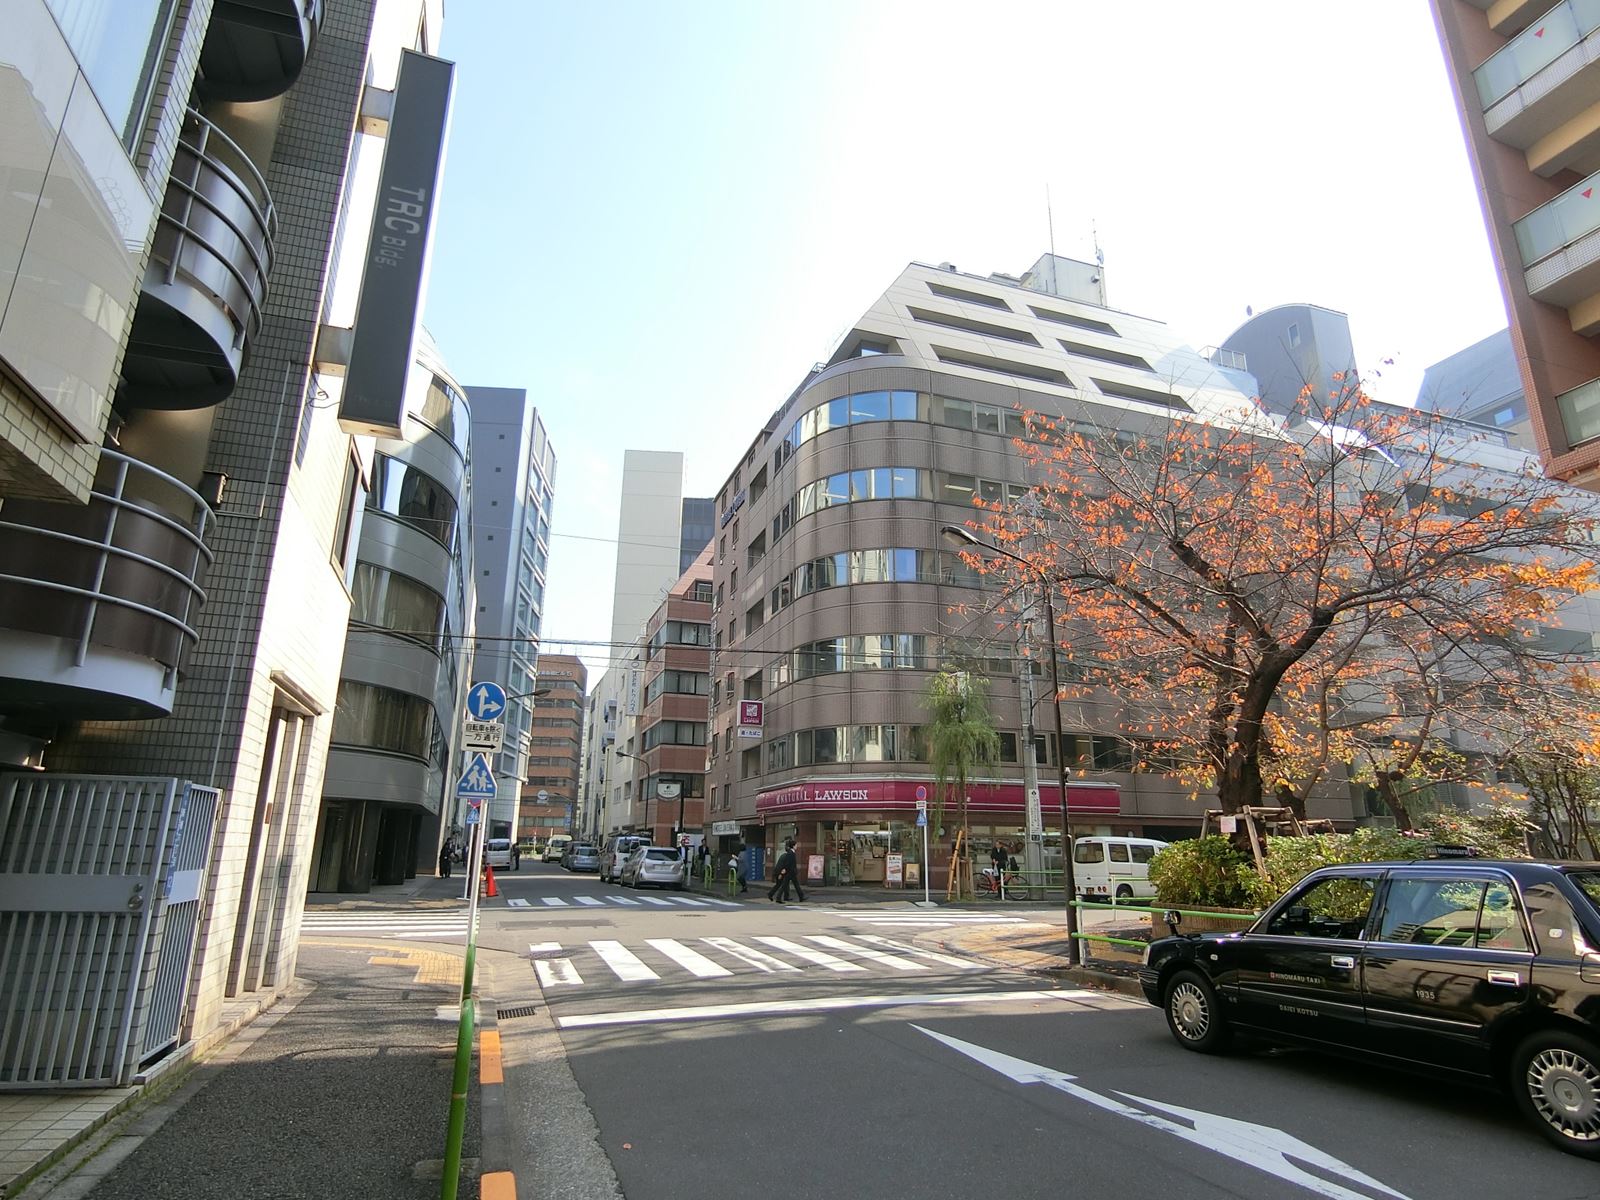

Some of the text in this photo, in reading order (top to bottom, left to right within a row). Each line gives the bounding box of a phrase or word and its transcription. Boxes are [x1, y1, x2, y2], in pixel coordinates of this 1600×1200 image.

[384, 186, 426, 234] TRC
[466, 723, 501, 733] 自転車を除く
[465, 733, 500, 742] 一方通行
[780, 789, 868, 804] NATURAL LAWSON
[1307, 976, 1321, 984] TAXI
[1415, 990, 1435, 999] 1935
[1296, 1007, 1319, 1017] KOTSU
